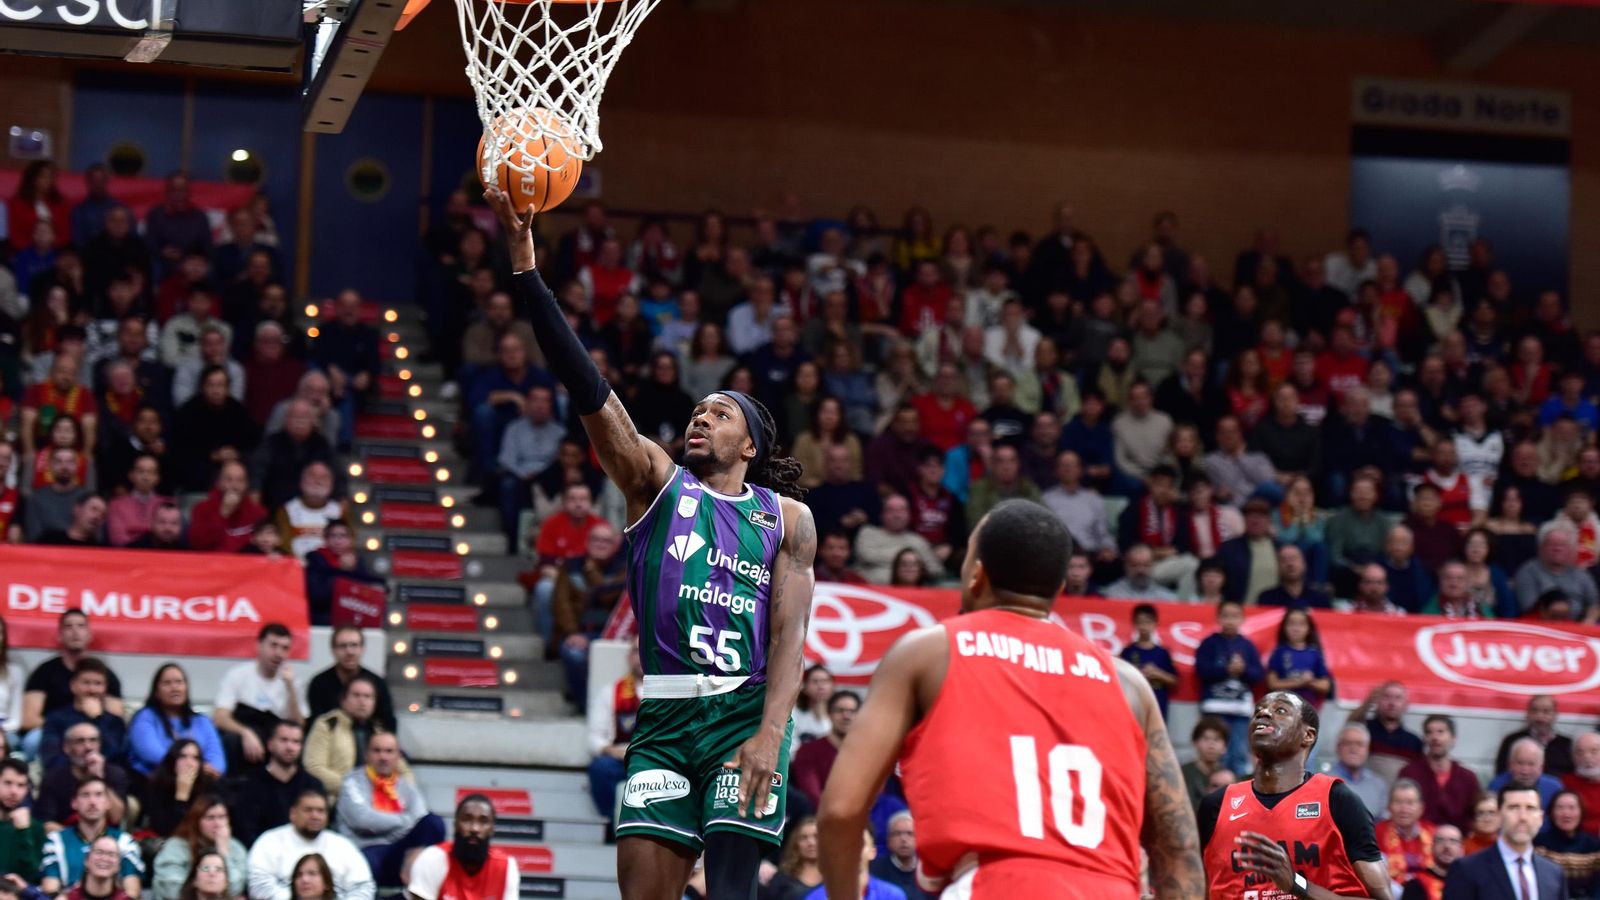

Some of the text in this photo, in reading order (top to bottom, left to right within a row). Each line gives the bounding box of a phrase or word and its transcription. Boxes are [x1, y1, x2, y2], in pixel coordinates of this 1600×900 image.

[1475, 94, 1561, 125] Norte
[706, 548, 771, 586] Unicaja
[8, 583, 261, 622] DE MURCIA
[689, 624, 742, 672] 55
[956, 631, 1111, 683] CAUPAIN JR.
[1443, 632, 1587, 673] Juver
[714, 783, 740, 804] lag
[1009, 734, 1107, 849] 10
